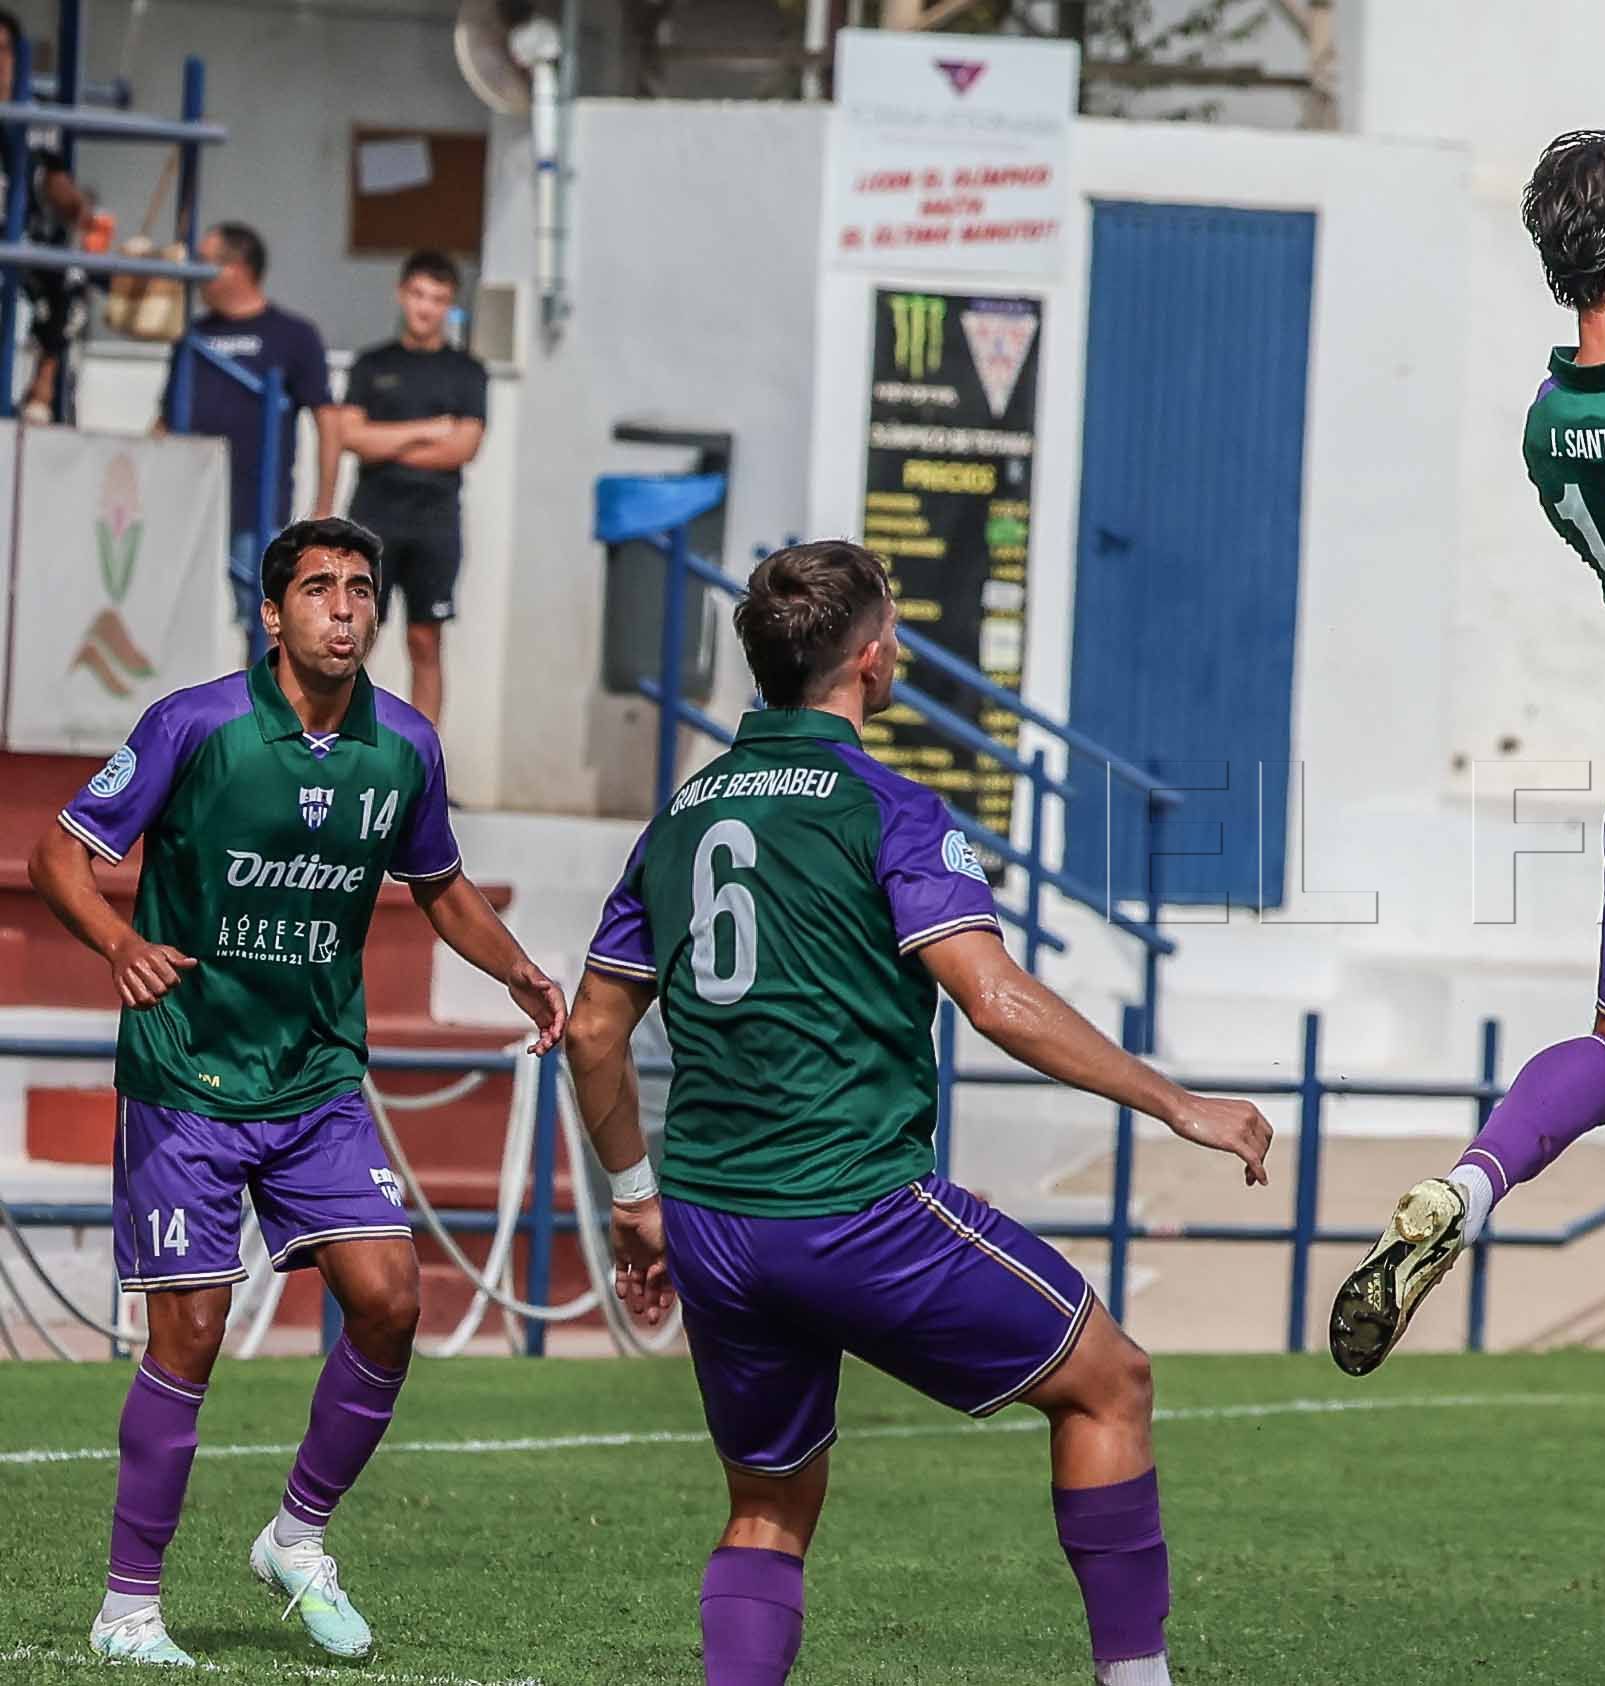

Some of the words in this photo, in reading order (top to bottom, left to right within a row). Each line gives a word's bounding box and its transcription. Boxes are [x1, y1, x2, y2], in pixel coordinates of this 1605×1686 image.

[1550, 427, 1563, 457] J.
[722, 767, 839, 799] BERNABEU
[359, 787, 399, 840] 14
[226, 849, 366, 893] Ontime
[221, 914, 306, 937] LÓPEZ
[690, 818, 757, 1005] 6
[218, 931, 285, 950] REAL
[147, 1208, 190, 1258] 14
